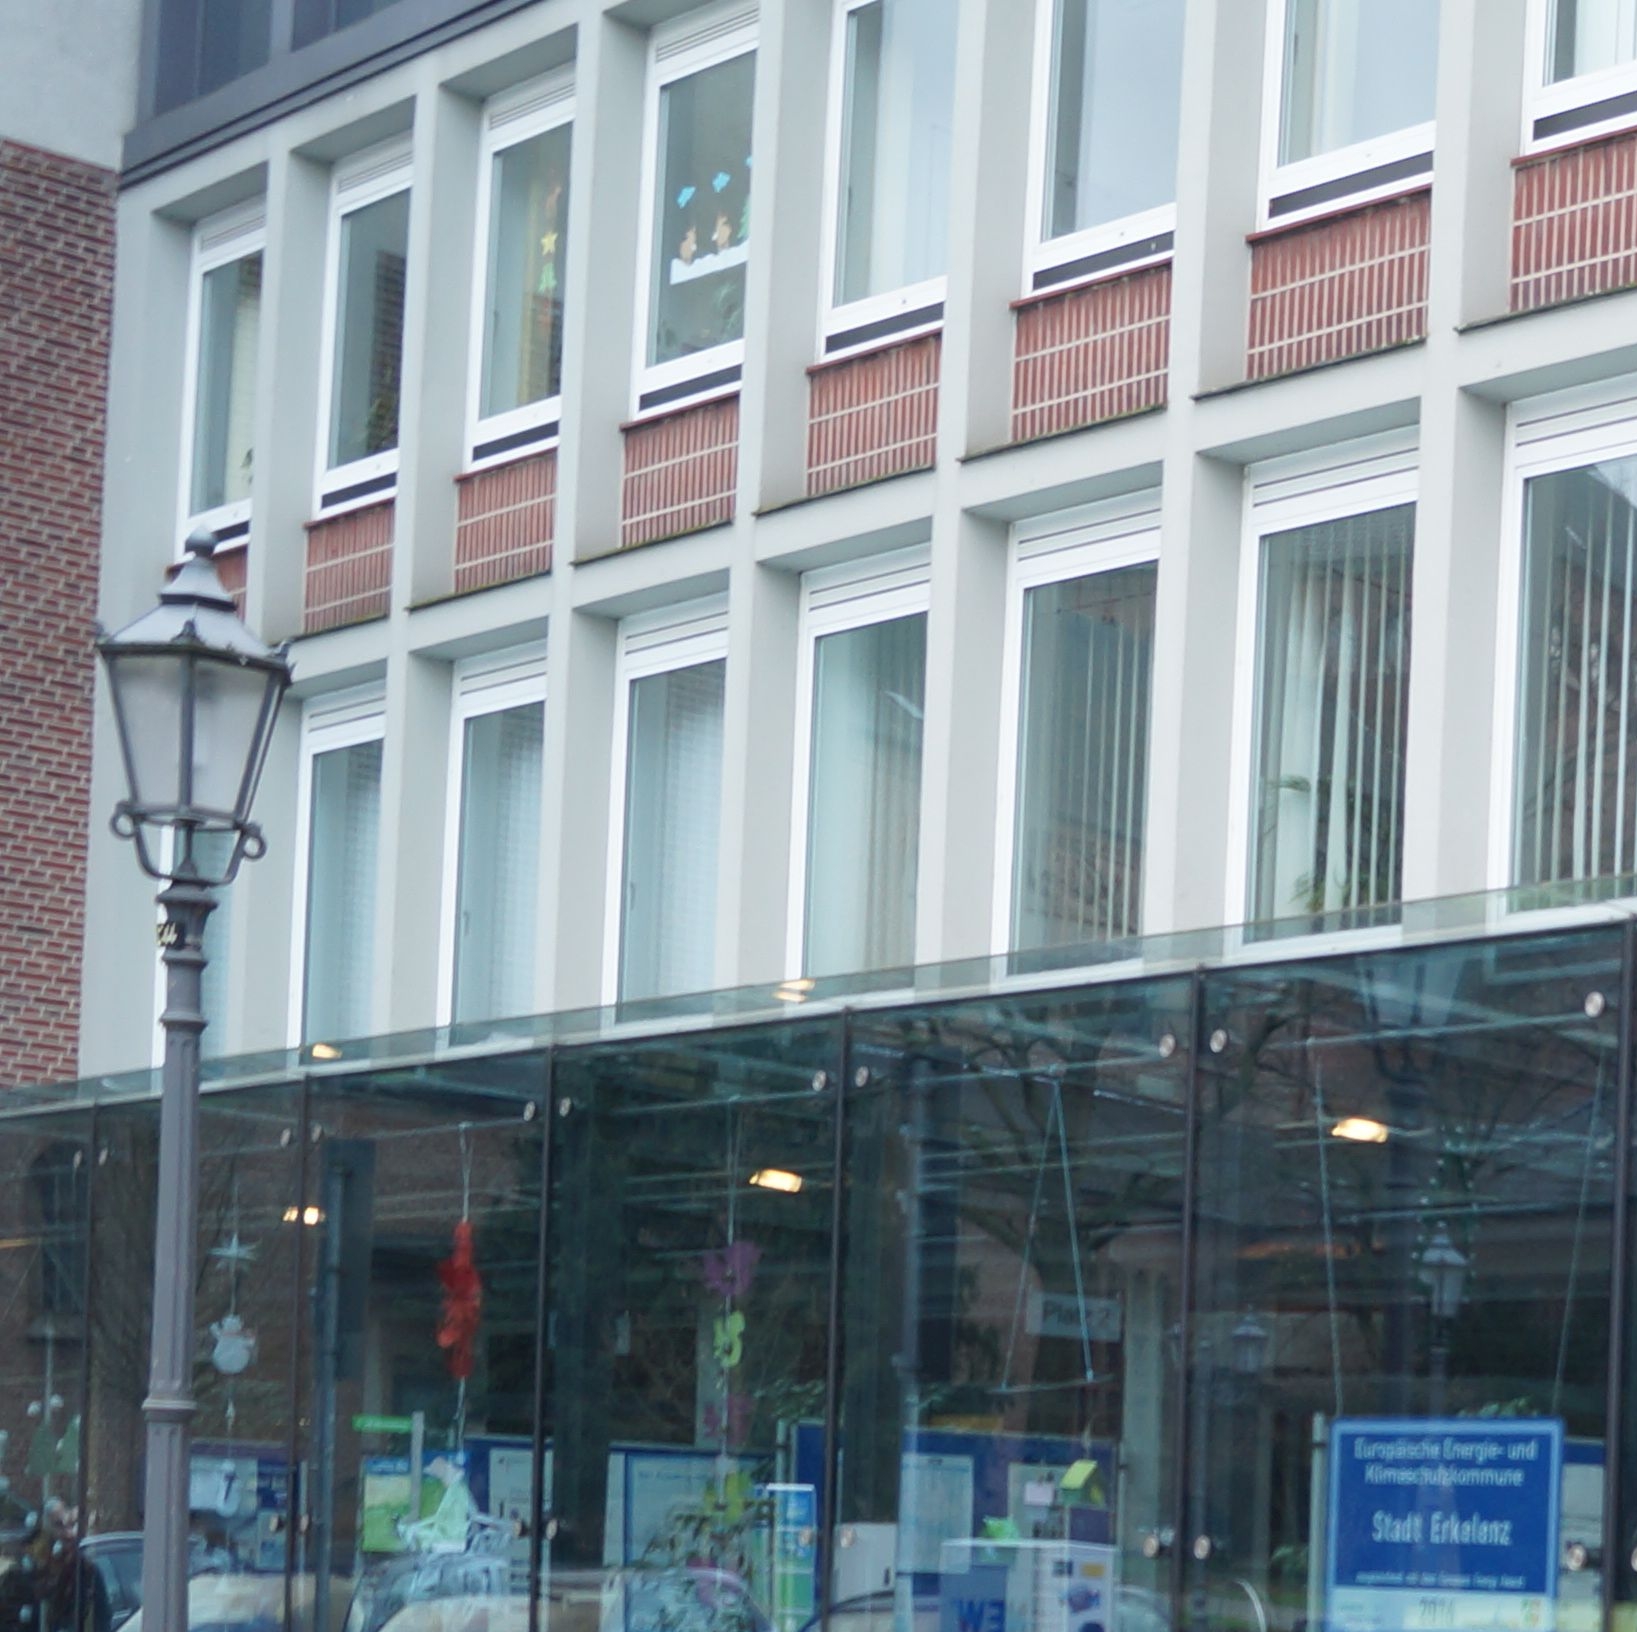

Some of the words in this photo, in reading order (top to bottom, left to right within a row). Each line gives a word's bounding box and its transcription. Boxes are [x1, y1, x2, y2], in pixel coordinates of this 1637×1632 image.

[1507, 1438, 1539, 1461] und
[1372, 1510, 1423, 1543] Stadt
[1430, 1511, 1513, 1546] Erkelenz
